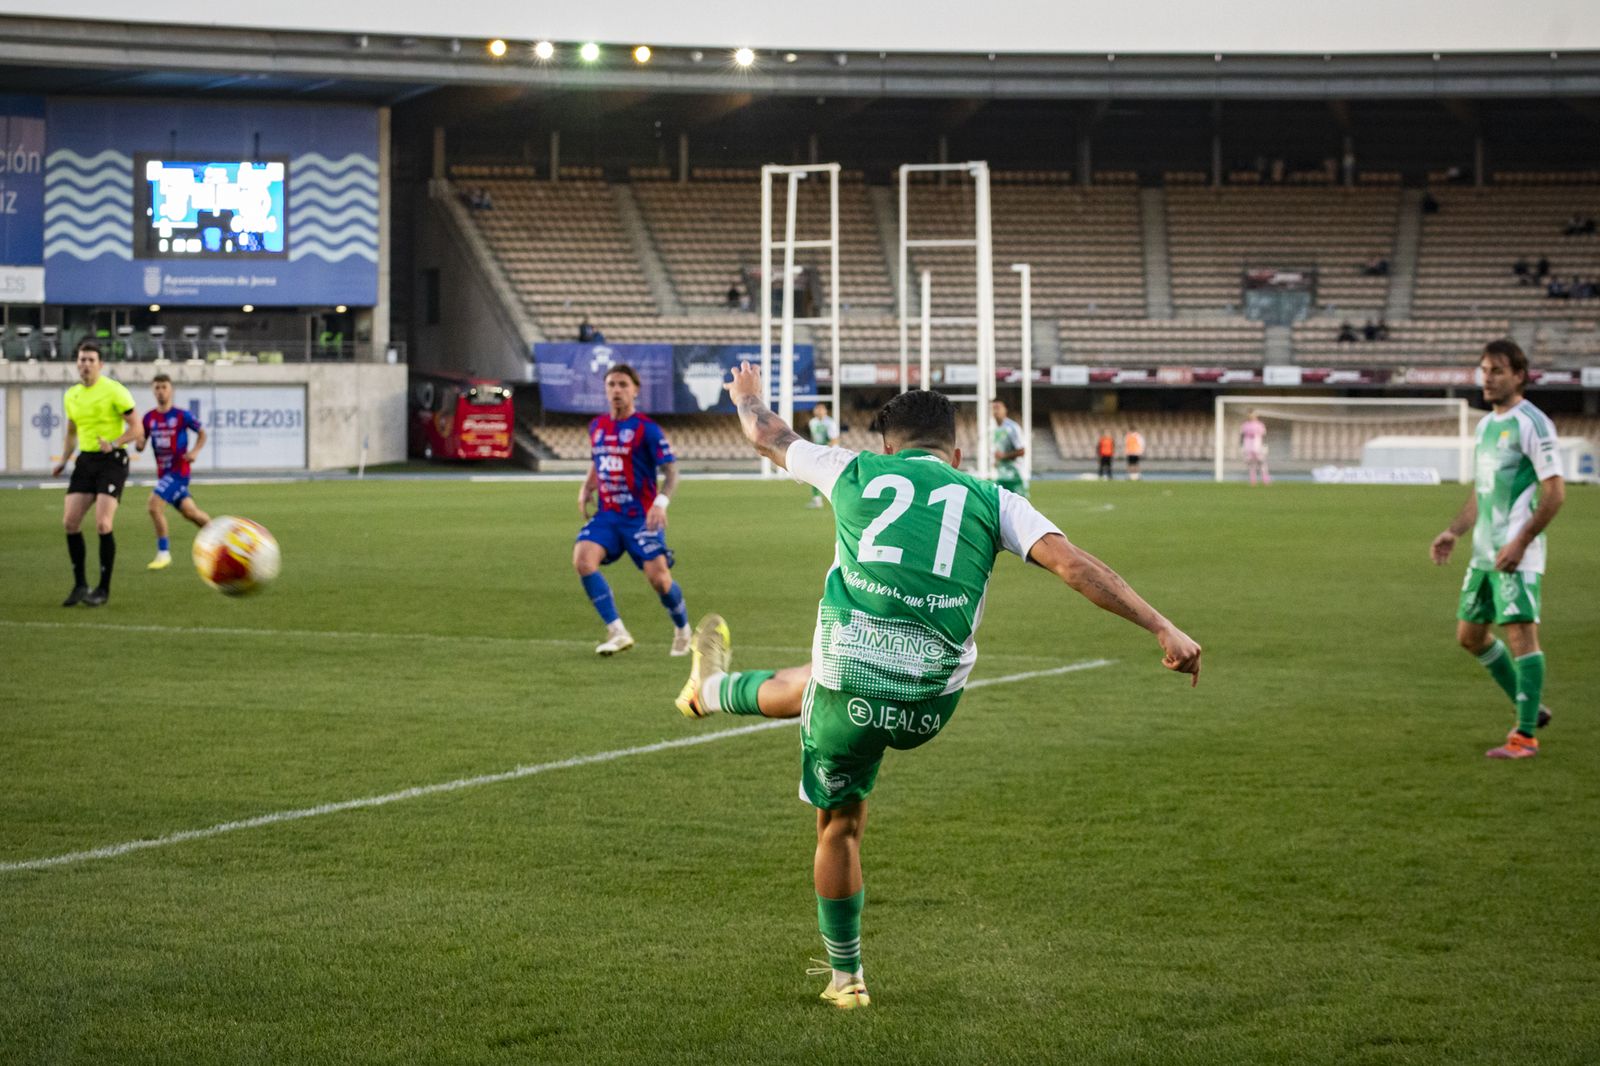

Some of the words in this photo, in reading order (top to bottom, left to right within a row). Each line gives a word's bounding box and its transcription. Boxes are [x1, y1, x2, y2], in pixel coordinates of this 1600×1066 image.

[206, 408, 302, 429] JEREZ2031
[857, 473, 969, 577] 21
[851, 628, 944, 658] JIMANG
[857, 650, 896, 664] Aplicadora
[896, 659, 942, 671] Homologada
[873, 705, 941, 735] JEALSA
